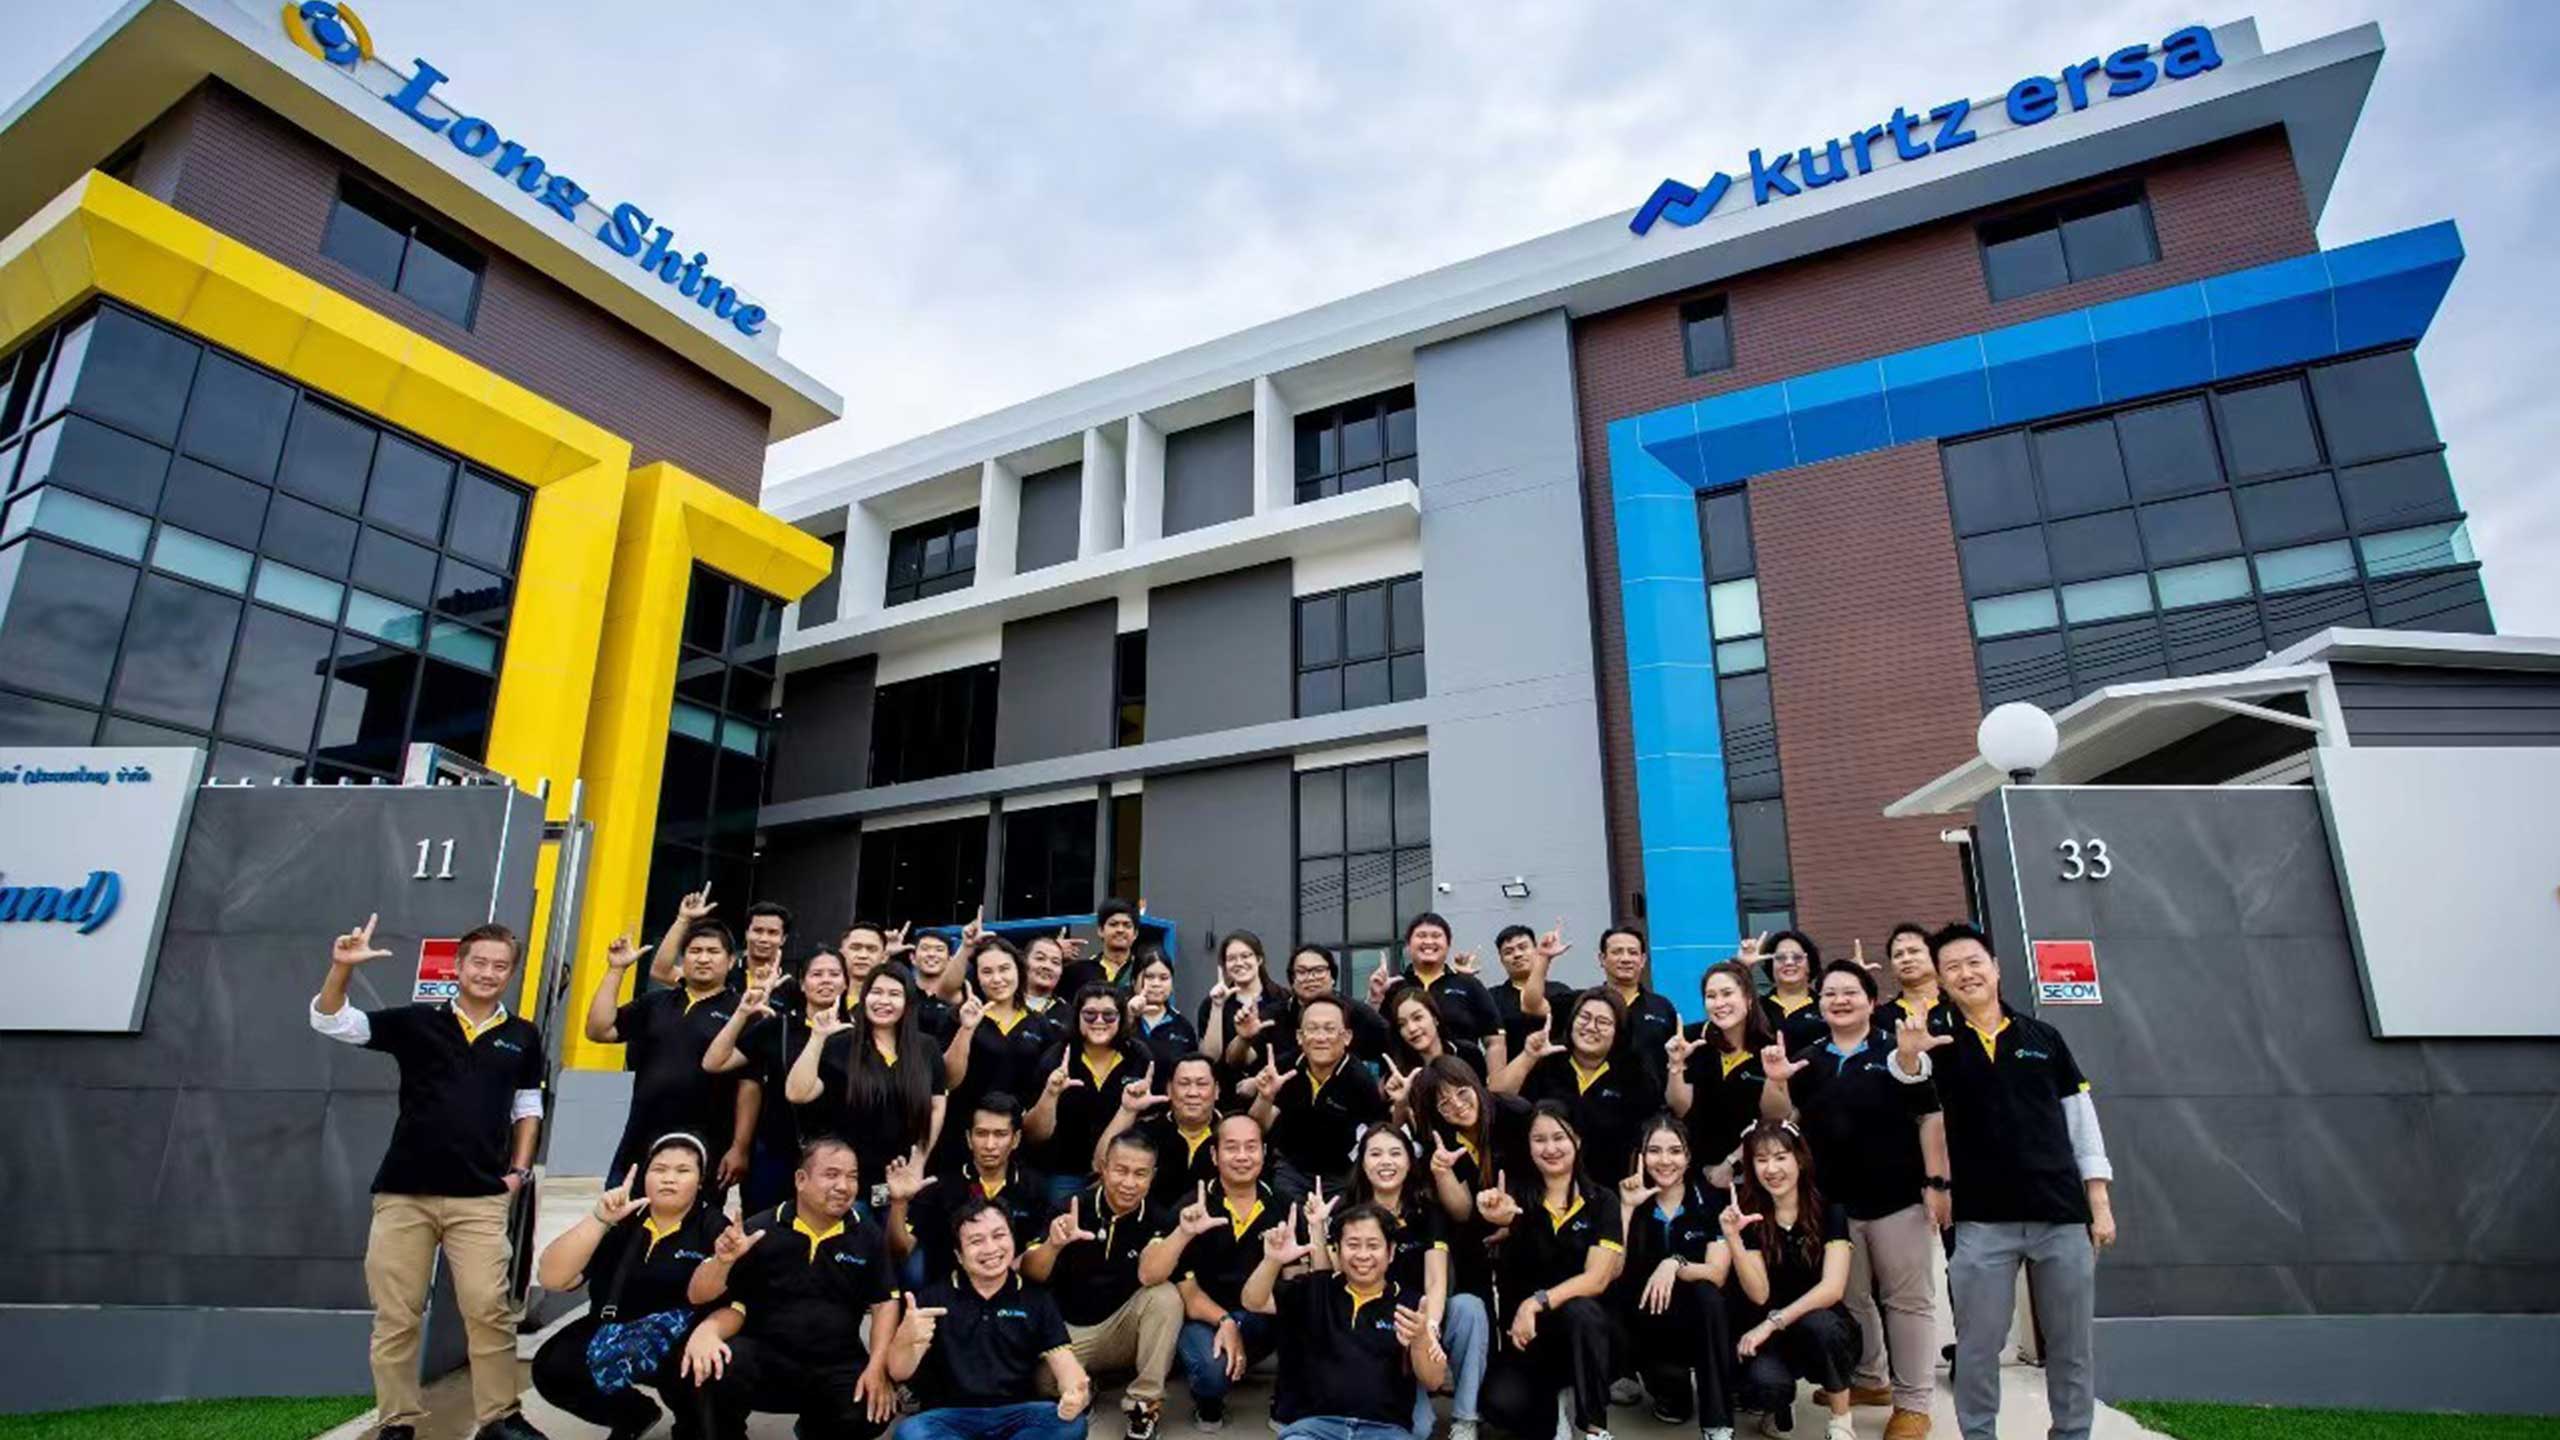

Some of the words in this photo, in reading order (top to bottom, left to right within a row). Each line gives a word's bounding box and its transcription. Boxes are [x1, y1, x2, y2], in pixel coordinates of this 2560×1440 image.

[1748, 97, 1979, 206] kurtz
[2003, 23, 2226, 127] ersa
[383, 57, 589, 223] Long
[593, 200, 768, 339] Shine
[412, 838, 455, 879] 11
[2059, 838, 2113, 879] 33
[418, 982, 460, 997] SECO
[2043, 984, 2097, 998] SECOM
